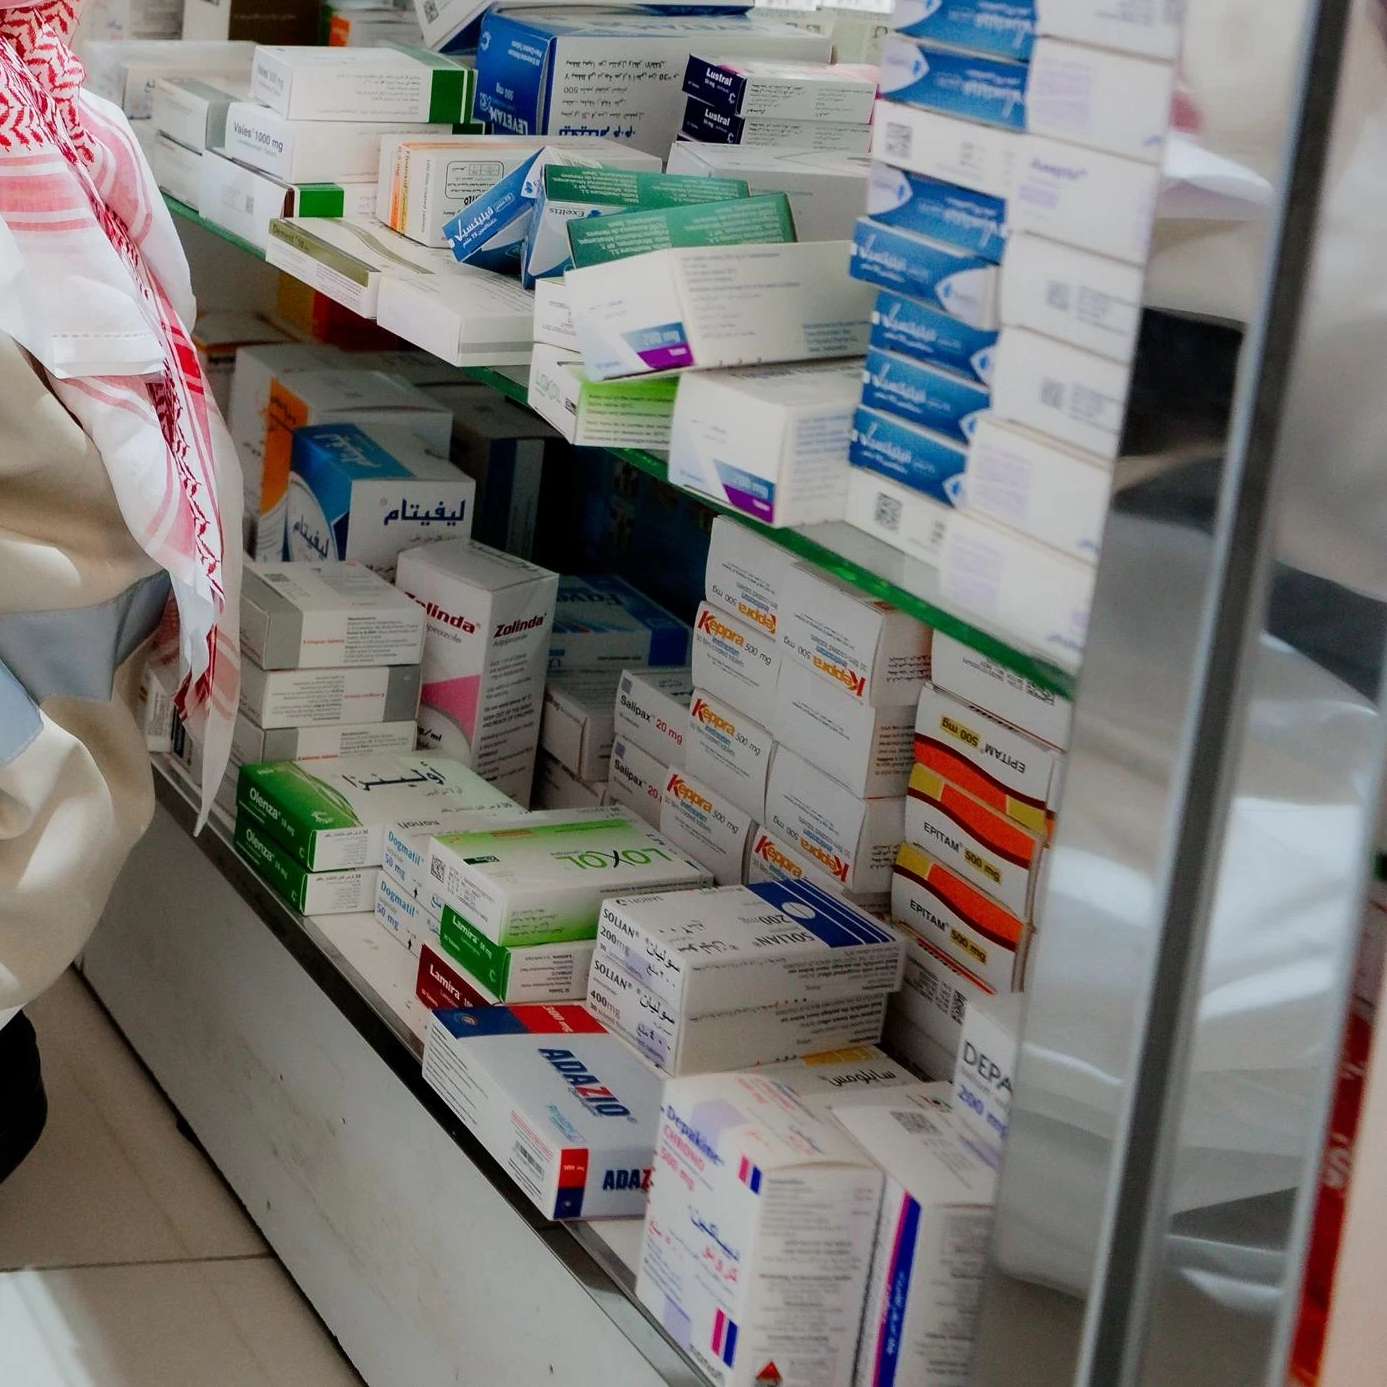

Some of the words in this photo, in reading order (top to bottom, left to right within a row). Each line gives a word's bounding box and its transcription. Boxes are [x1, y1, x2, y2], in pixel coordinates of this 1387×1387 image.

[706, 67, 733, 87] Lustral
[490, 105, 529, 136] LEVETAM
[704, 108, 731, 126] Lustral
[233, 120, 253, 140] Vales
[254, 129, 270, 146] 1000
[271, 137, 284, 153] mg
[547, 207, 585, 218] Exeltis
[383, 496, 466, 527] ليفيتام
[292, 514, 329, 558] ليفيتام
[712, 584, 723, 598] mg
[724, 593, 737, 606] 500
[492, 613, 546, 639] Zolinda
[738, 601, 777, 635] Keppra
[697, 610, 745, 647] Keppra
[745, 642, 758, 656] 500
[759, 651, 773, 667] mg
[783, 635, 795, 650] mg
[794, 642, 810, 659] 500
[812, 652, 866, 698] Keppra
[620, 694, 652, 724] Salipax
[655, 718, 667, 734] 20
[667, 728, 684, 747] mg
[690, 697, 736, 738] Keppra
[735, 730, 749, 749] 500
[748, 739, 762, 756] mg
[939, 715, 958, 738] mg
[960, 727, 980, 748] 500
[613, 759, 644, 789] Salipax
[647, 784, 659, 800] 20
[666, 772, 712, 815] Keppra
[711, 807, 726, 824] 500
[725, 815, 739, 834] mg
[772, 815, 785, 833] mg
[784, 826, 800, 843] 500
[384, 853, 394, 868] 50
[394, 864, 407, 882] mg
[554, 847, 674, 870] LOXOL
[755, 834, 802, 880] Keppra
[800, 836, 851, 883] Keppra
[964, 848, 982, 872] 500
[981, 857, 1002, 882] mg
[376, 902, 386, 918] 50
[386, 911, 400, 931] mg
[452, 915, 480, 945] Lamira
[950, 929, 969, 954] 500
[968, 939, 988, 966] mg
[429, 963, 461, 1001] Lamira
[537, 1046, 632, 1117] ADAZIO
[962, 1039, 1014, 1094] DEPA
[665, 1104, 727, 1167] Depakine
[602, 1168, 653, 1192] ADAZ
